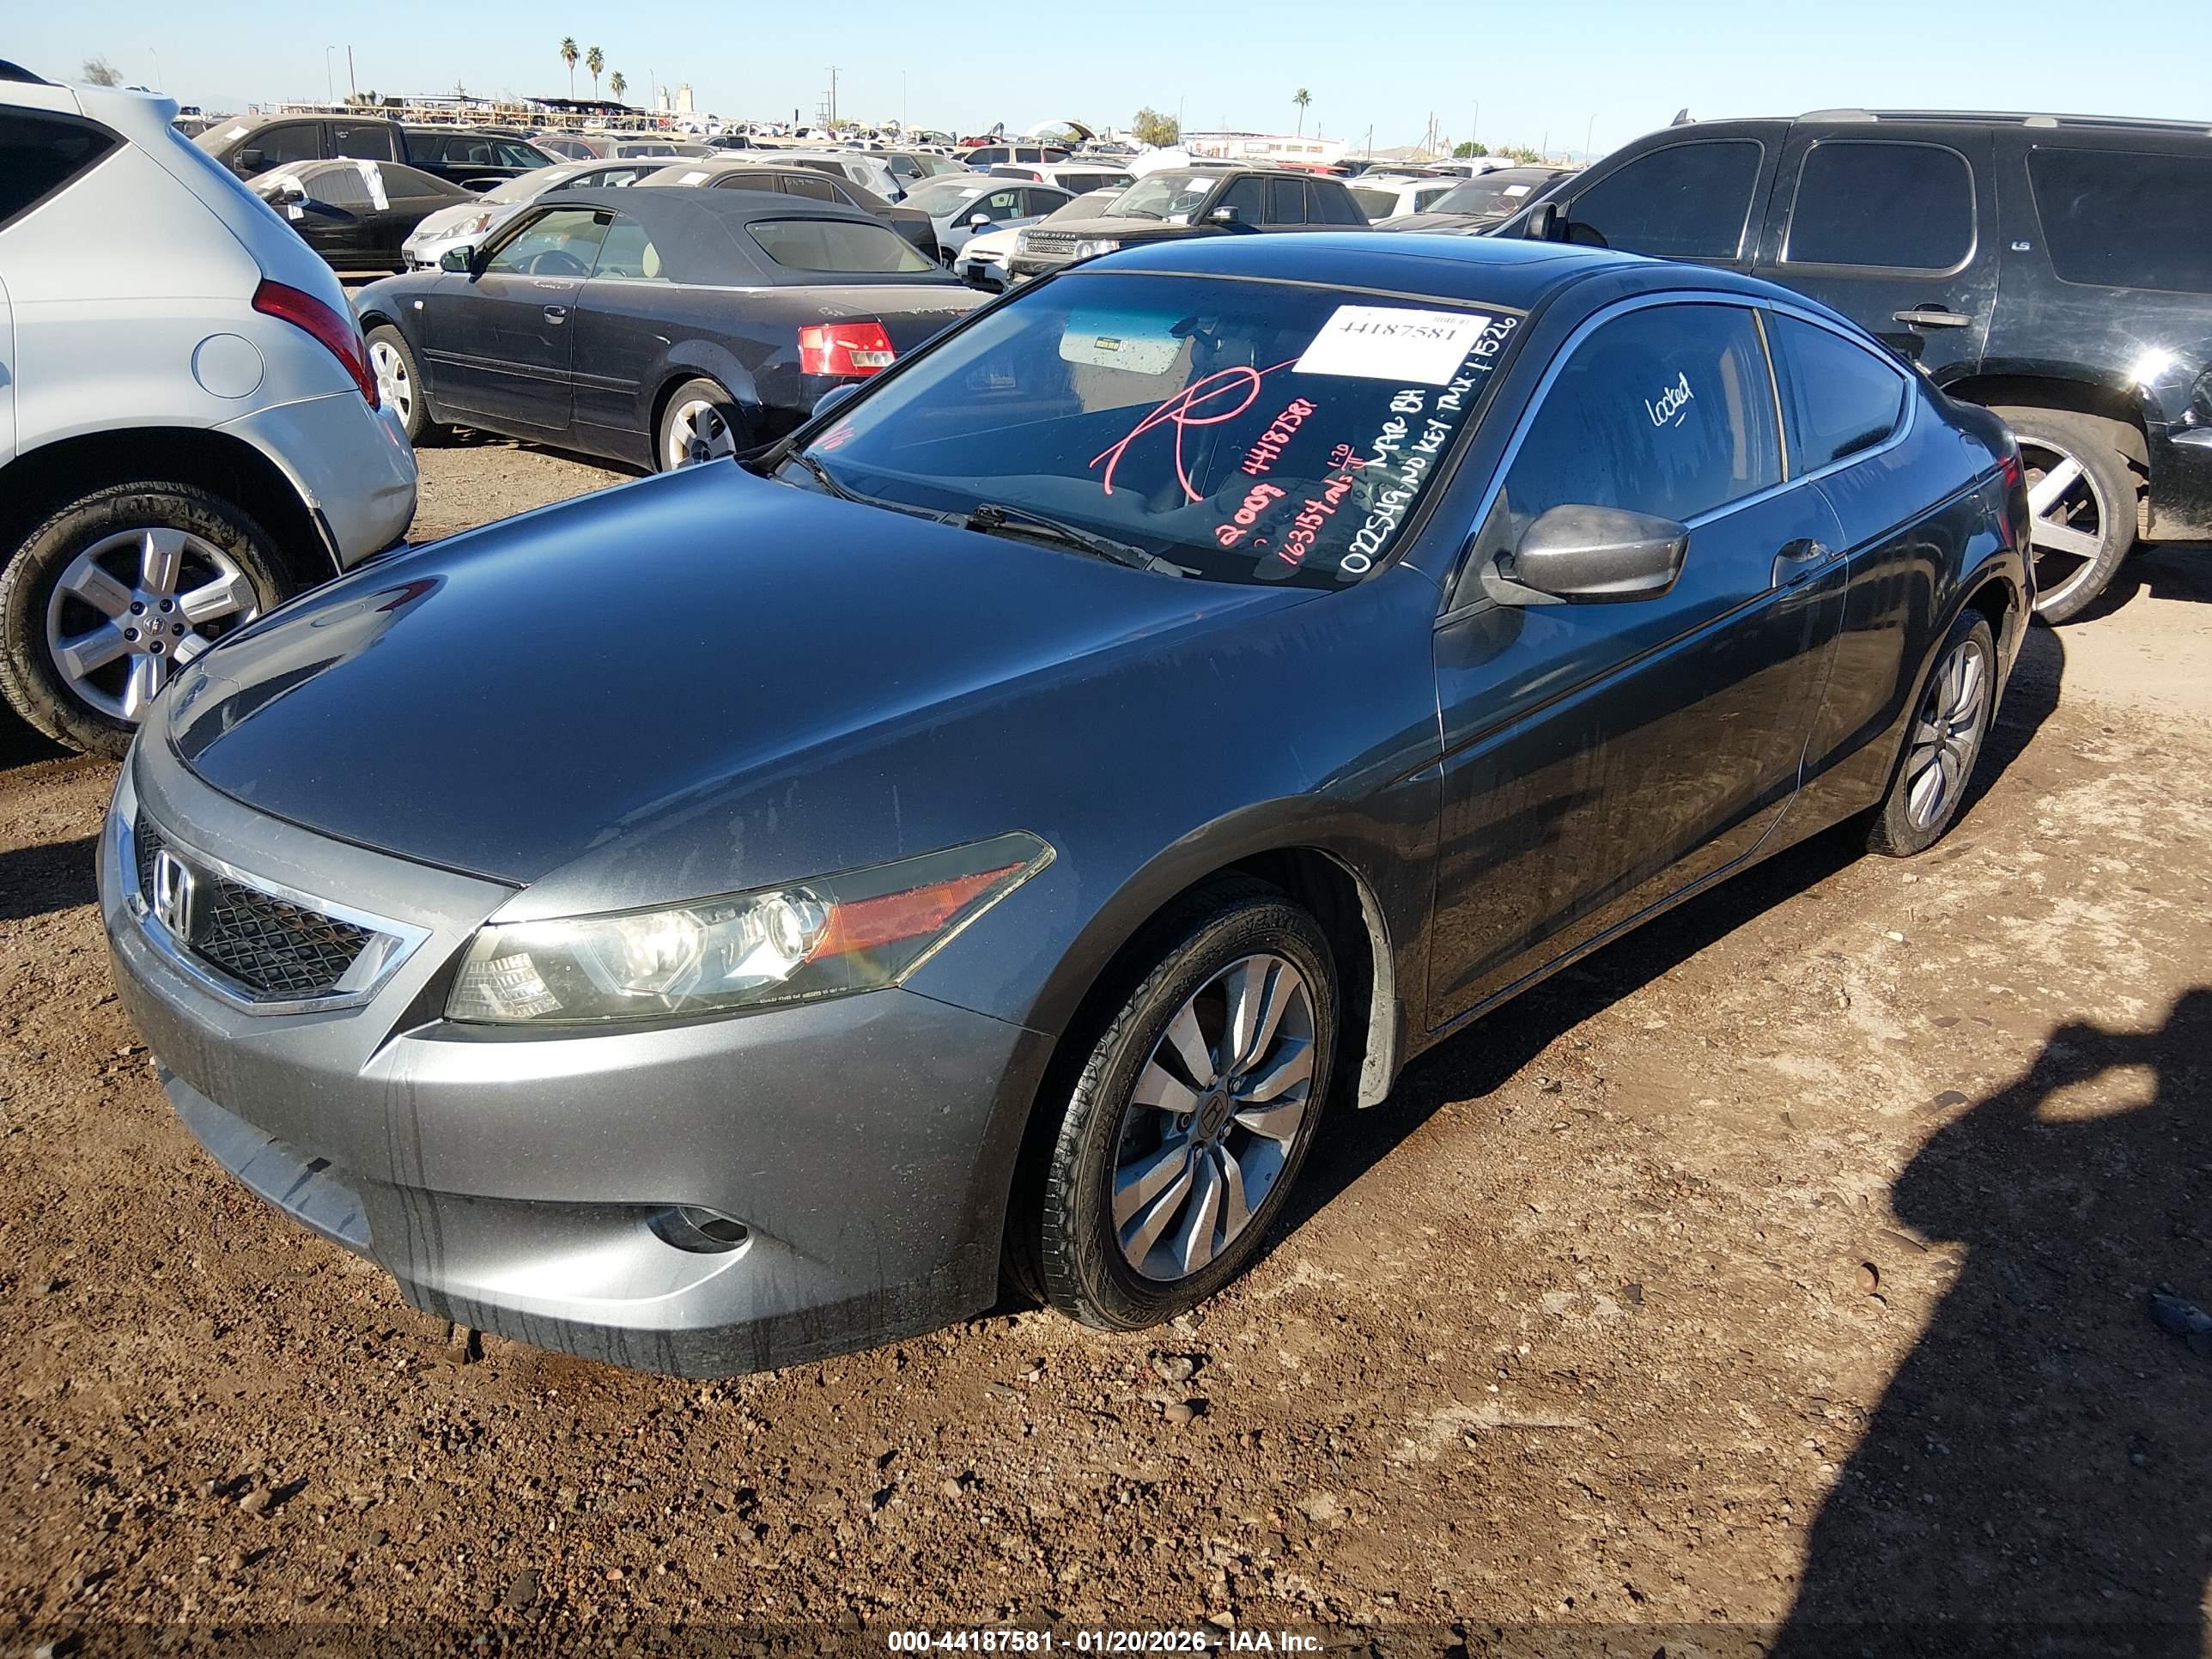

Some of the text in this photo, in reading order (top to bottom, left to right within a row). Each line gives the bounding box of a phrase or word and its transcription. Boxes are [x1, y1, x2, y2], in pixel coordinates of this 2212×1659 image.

[2011, 241, 2031, 252] LS
[1340, 321, 1457, 341] 44187581
[1645, 371, 1694, 427] locked
[1241, 398, 1318, 475] 44187581
[1279, 499, 1336, 566] 163154
